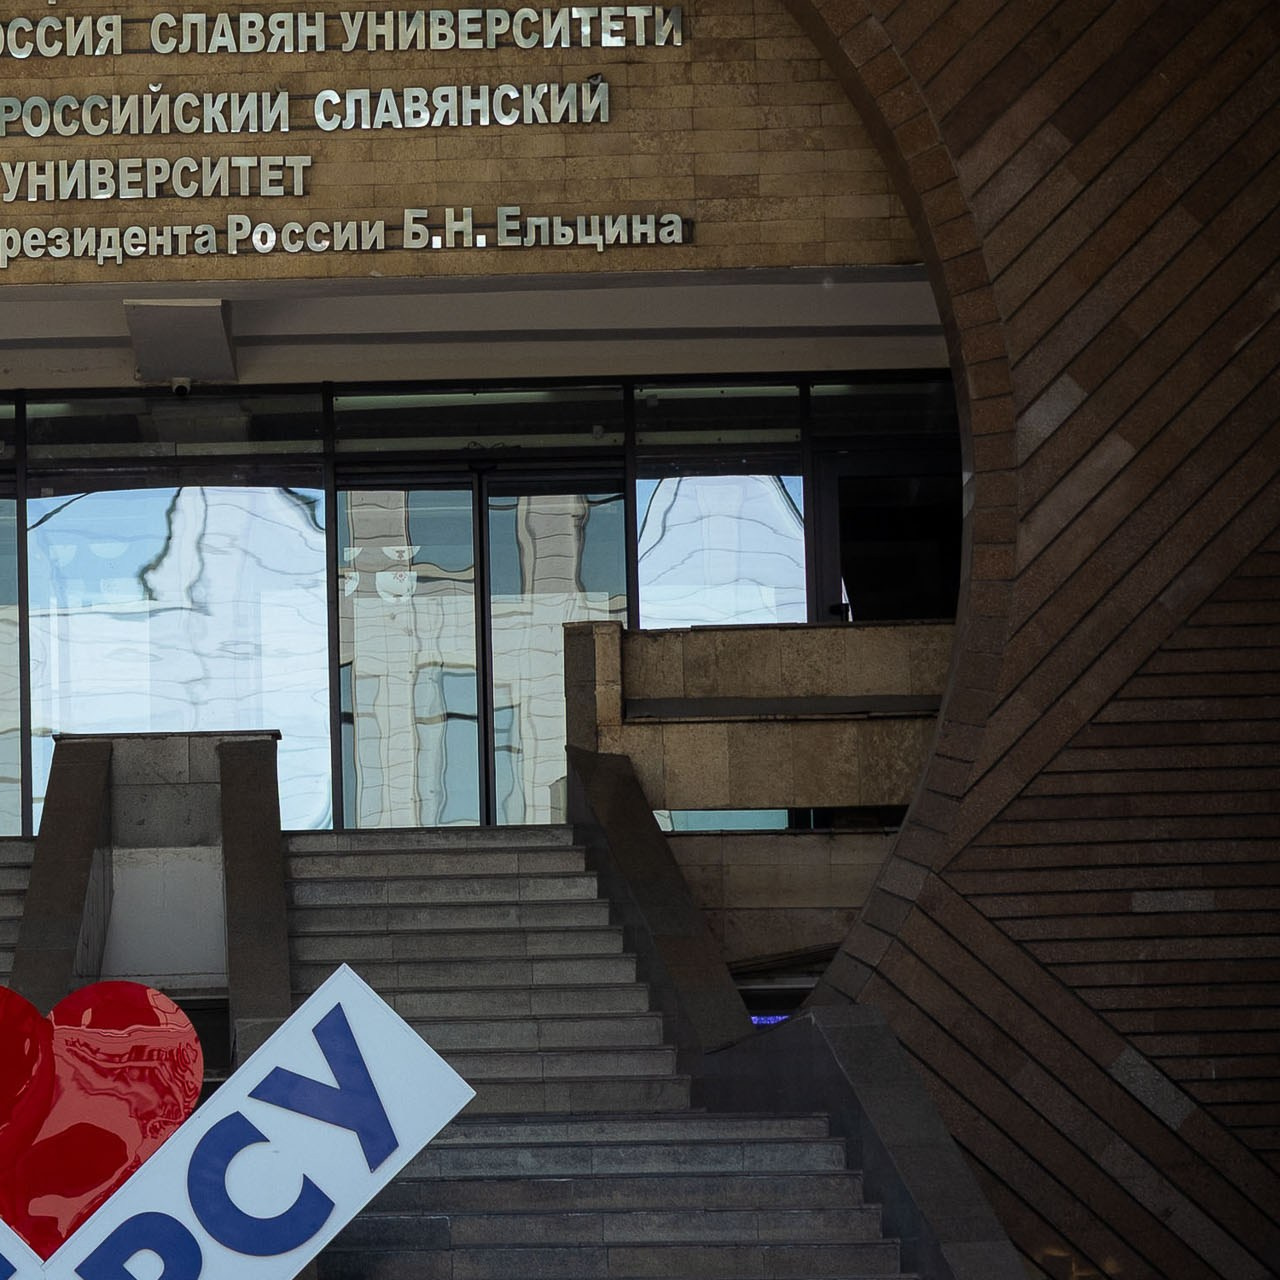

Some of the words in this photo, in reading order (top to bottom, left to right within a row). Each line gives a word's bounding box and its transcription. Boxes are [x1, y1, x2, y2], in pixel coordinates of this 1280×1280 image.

[150, 10, 326, 55] СЛАВЯН
[340, 5, 683, 53] УНИВЕРСИТЕТИ
[313, 73, 610, 131] СЛАВЯНСКИЙ
[1, 155, 312, 202] УНИВЕРСИТЕТ
[227, 214, 386, 255] России
